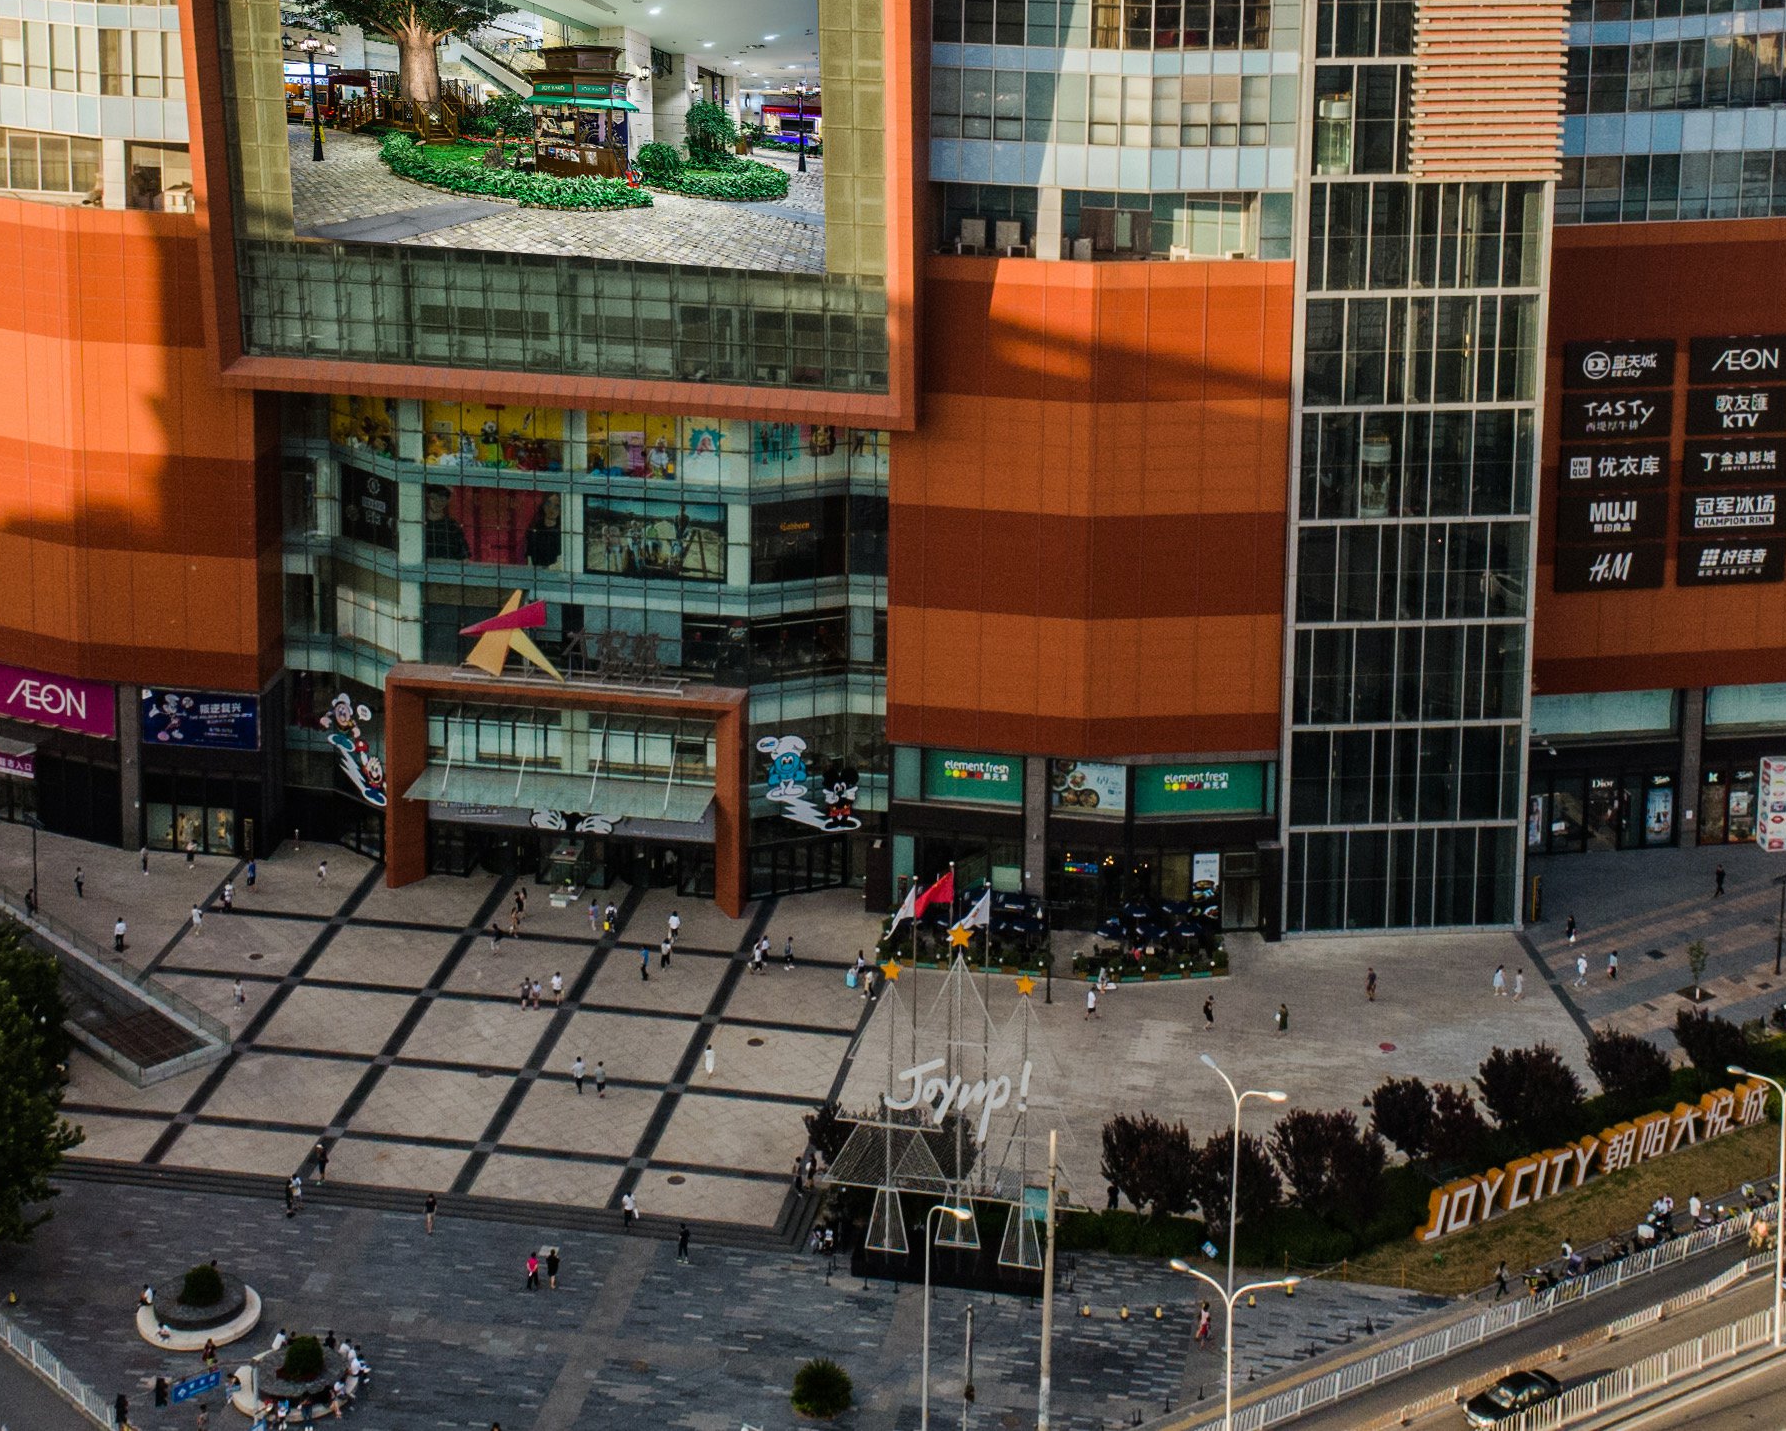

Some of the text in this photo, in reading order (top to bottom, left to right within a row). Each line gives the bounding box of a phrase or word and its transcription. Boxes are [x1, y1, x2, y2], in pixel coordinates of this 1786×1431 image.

[1722, 413, 1759, 428] KTV
[1598, 455, 1661, 478] 优衣库
[1589, 501, 1638, 522] MUJI
[1695, 495, 1776, 516] 冠军冰场
[1696, 515, 1772, 527] CHAMPION RINK
[1589, 552, 1633, 582] H&M
[944, 759, 1010, 775] element fresh
[1164, 771, 1229, 784] element fresh
[1592, 778, 1615, 788] Dior
[1425, 1084, 1770, 1241] JOY CITY 朝阳大悦城
